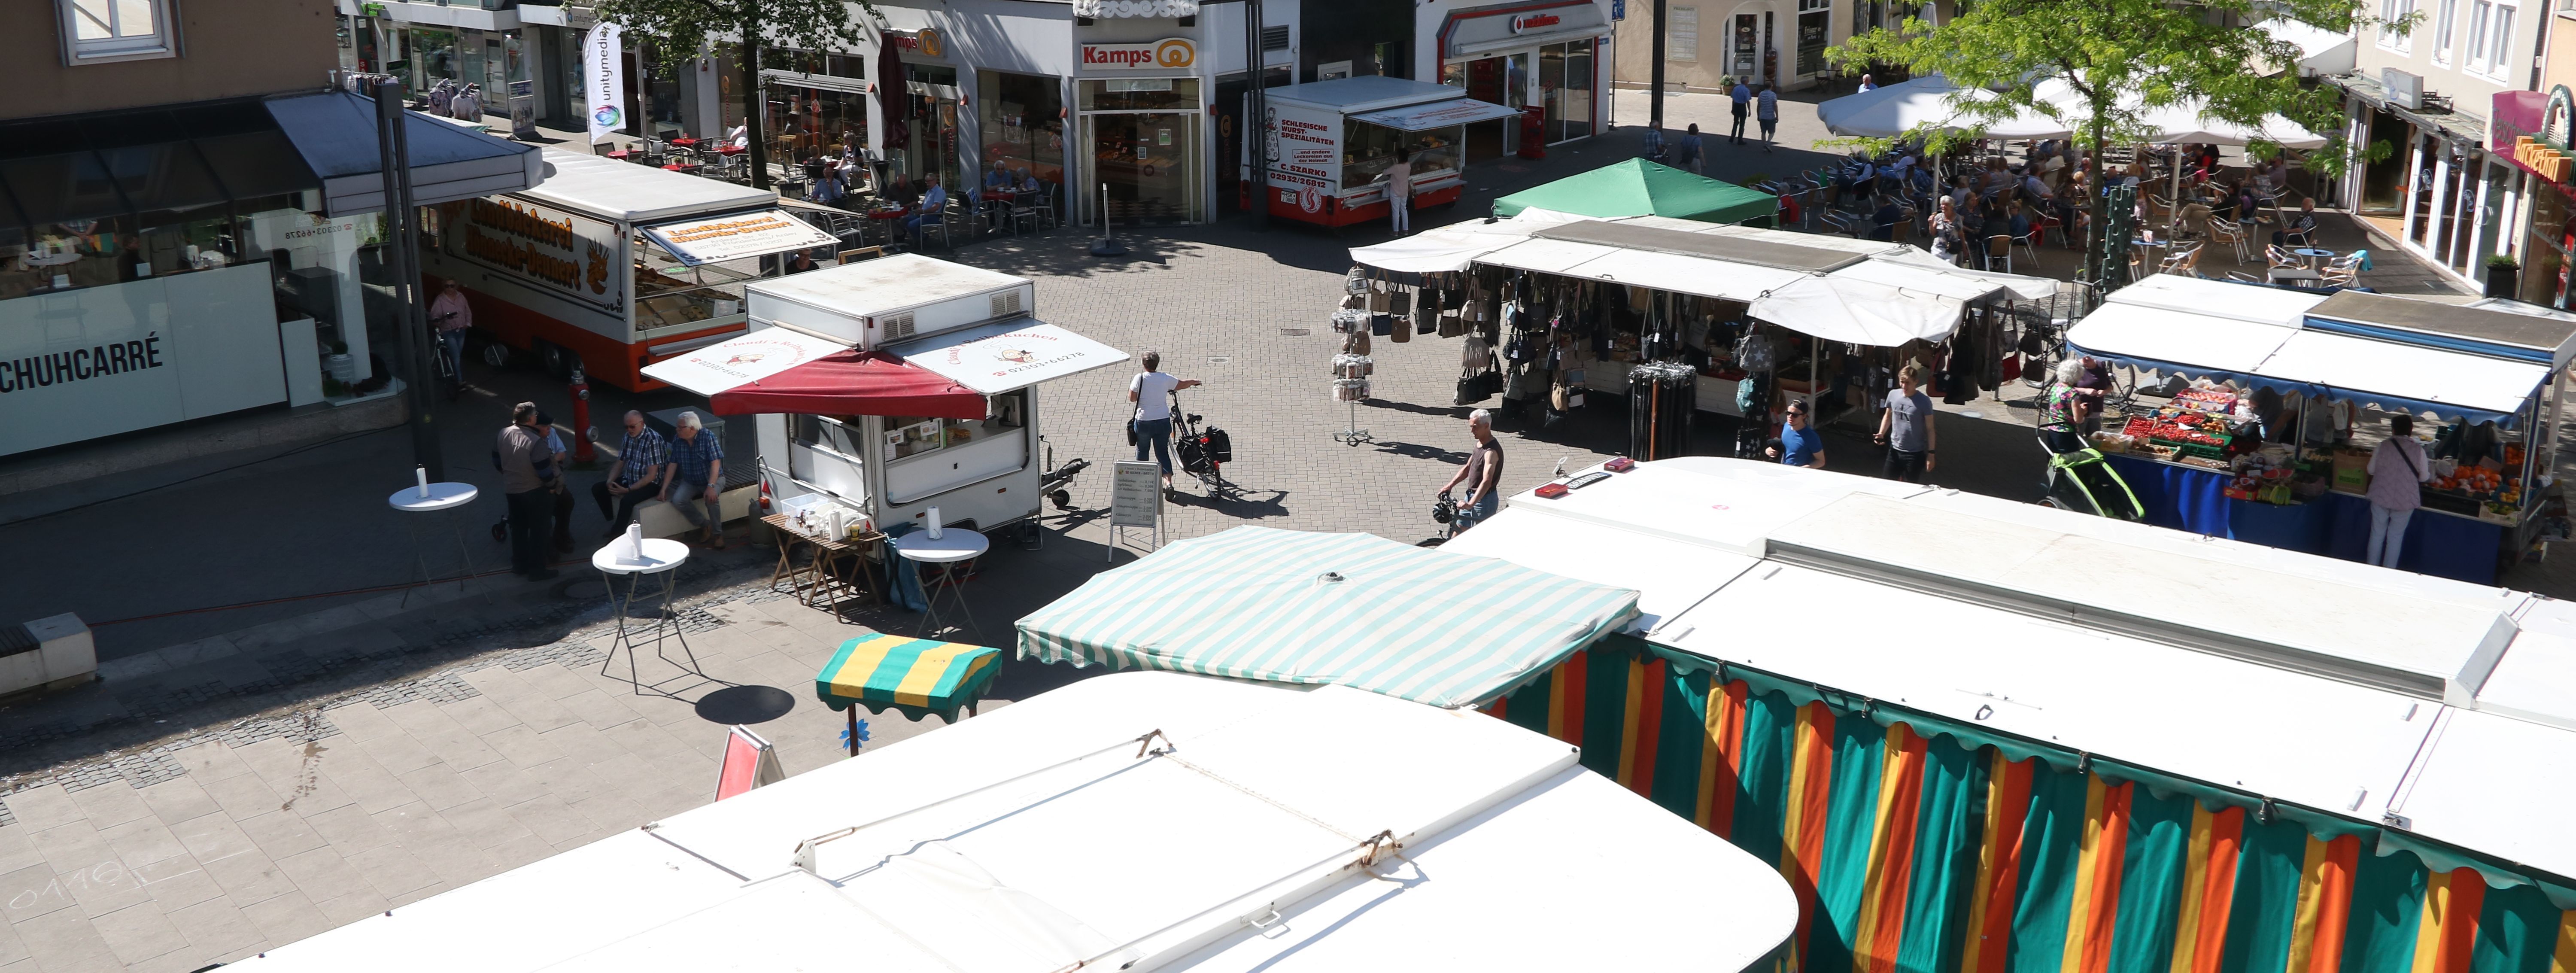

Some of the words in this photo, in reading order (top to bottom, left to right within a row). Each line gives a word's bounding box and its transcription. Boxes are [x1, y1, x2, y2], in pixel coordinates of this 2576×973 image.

[574, 14, 596, 25] unitymed
[1524, 14, 1560, 28] vodafone
[598, 30, 613, 100] unitymedia
[1083, 46, 1152, 67] Kamps
[1282, 119, 1328, 131] SCHLESISCHE
[2493, 108, 2532, 145] Fleisch
[1281, 133, 1334, 146] SPEZIALITÄTEN
[2514, 136, 2560, 182] Hackethal
[1270, 172, 1326, 188] 02932/26812
[1290, 165, 1327, 177] SZARKO
[470, 198, 574, 252] Landbäckerei
[666, 216, 778, 237] Landbäckerei
